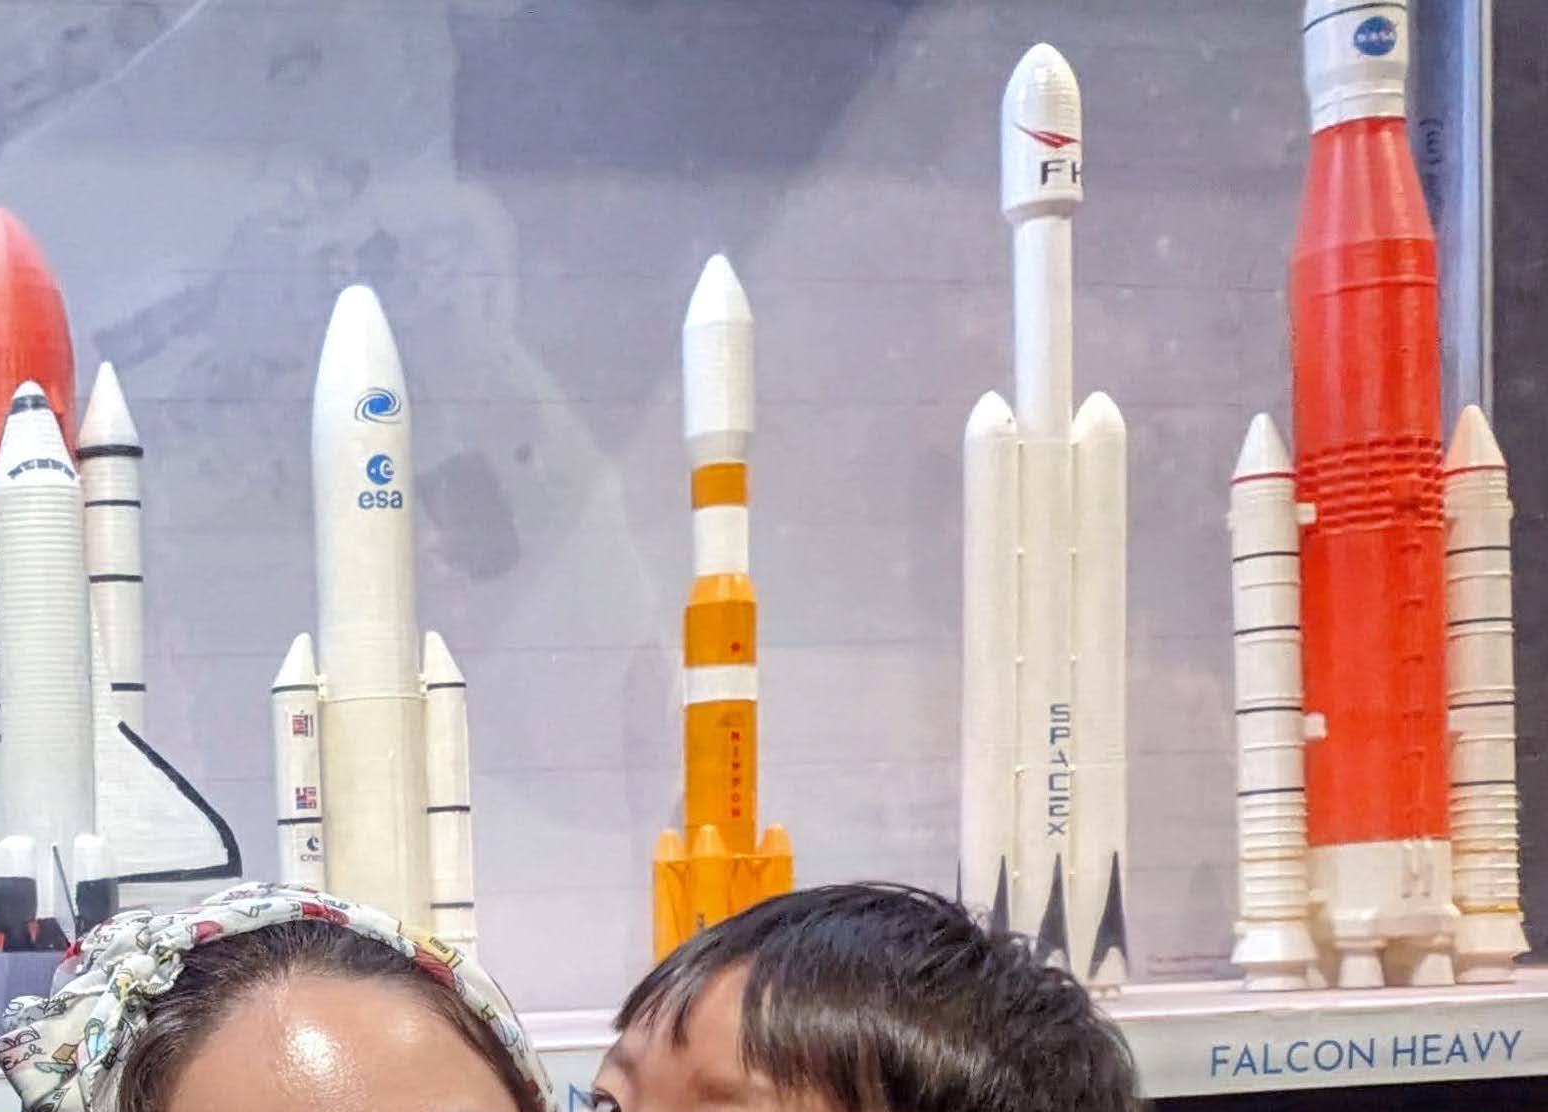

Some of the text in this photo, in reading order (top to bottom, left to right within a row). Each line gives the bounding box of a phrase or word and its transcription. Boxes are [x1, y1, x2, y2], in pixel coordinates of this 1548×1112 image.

[358, 490, 403, 509] esa
[1210, 1030, 1523, 1077] FALCON HEAVY
